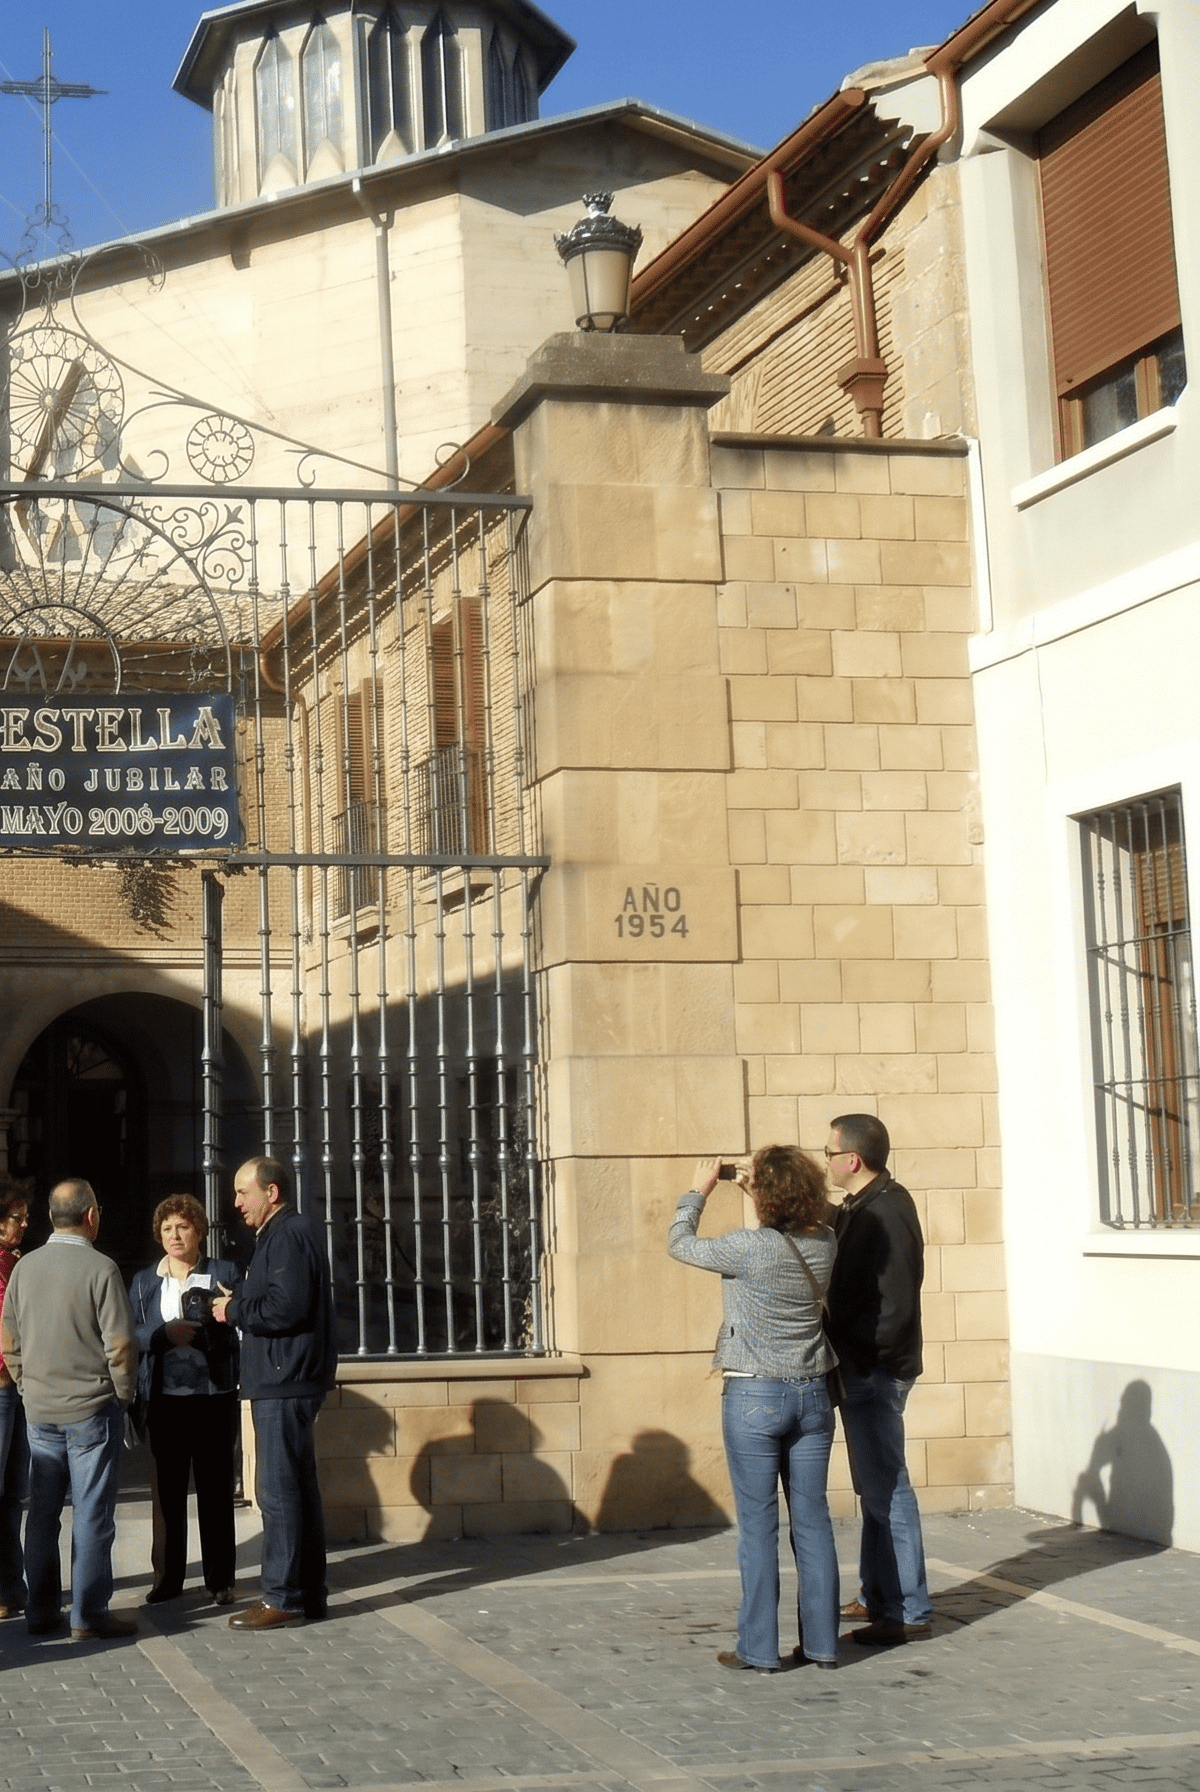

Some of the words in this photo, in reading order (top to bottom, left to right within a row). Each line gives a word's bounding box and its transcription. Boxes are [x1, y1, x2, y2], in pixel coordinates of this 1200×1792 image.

[0, 707, 226, 752] ESTELLA
[0, 763, 66, 791] AÑO
[84, 766, 229, 791] JUBILAR
[0, 801, 83, 835] MAYO
[88, 803, 229, 839] 2008-2009
[623, 882, 681, 912] AÑO
[614, 914, 689, 938] 1954
